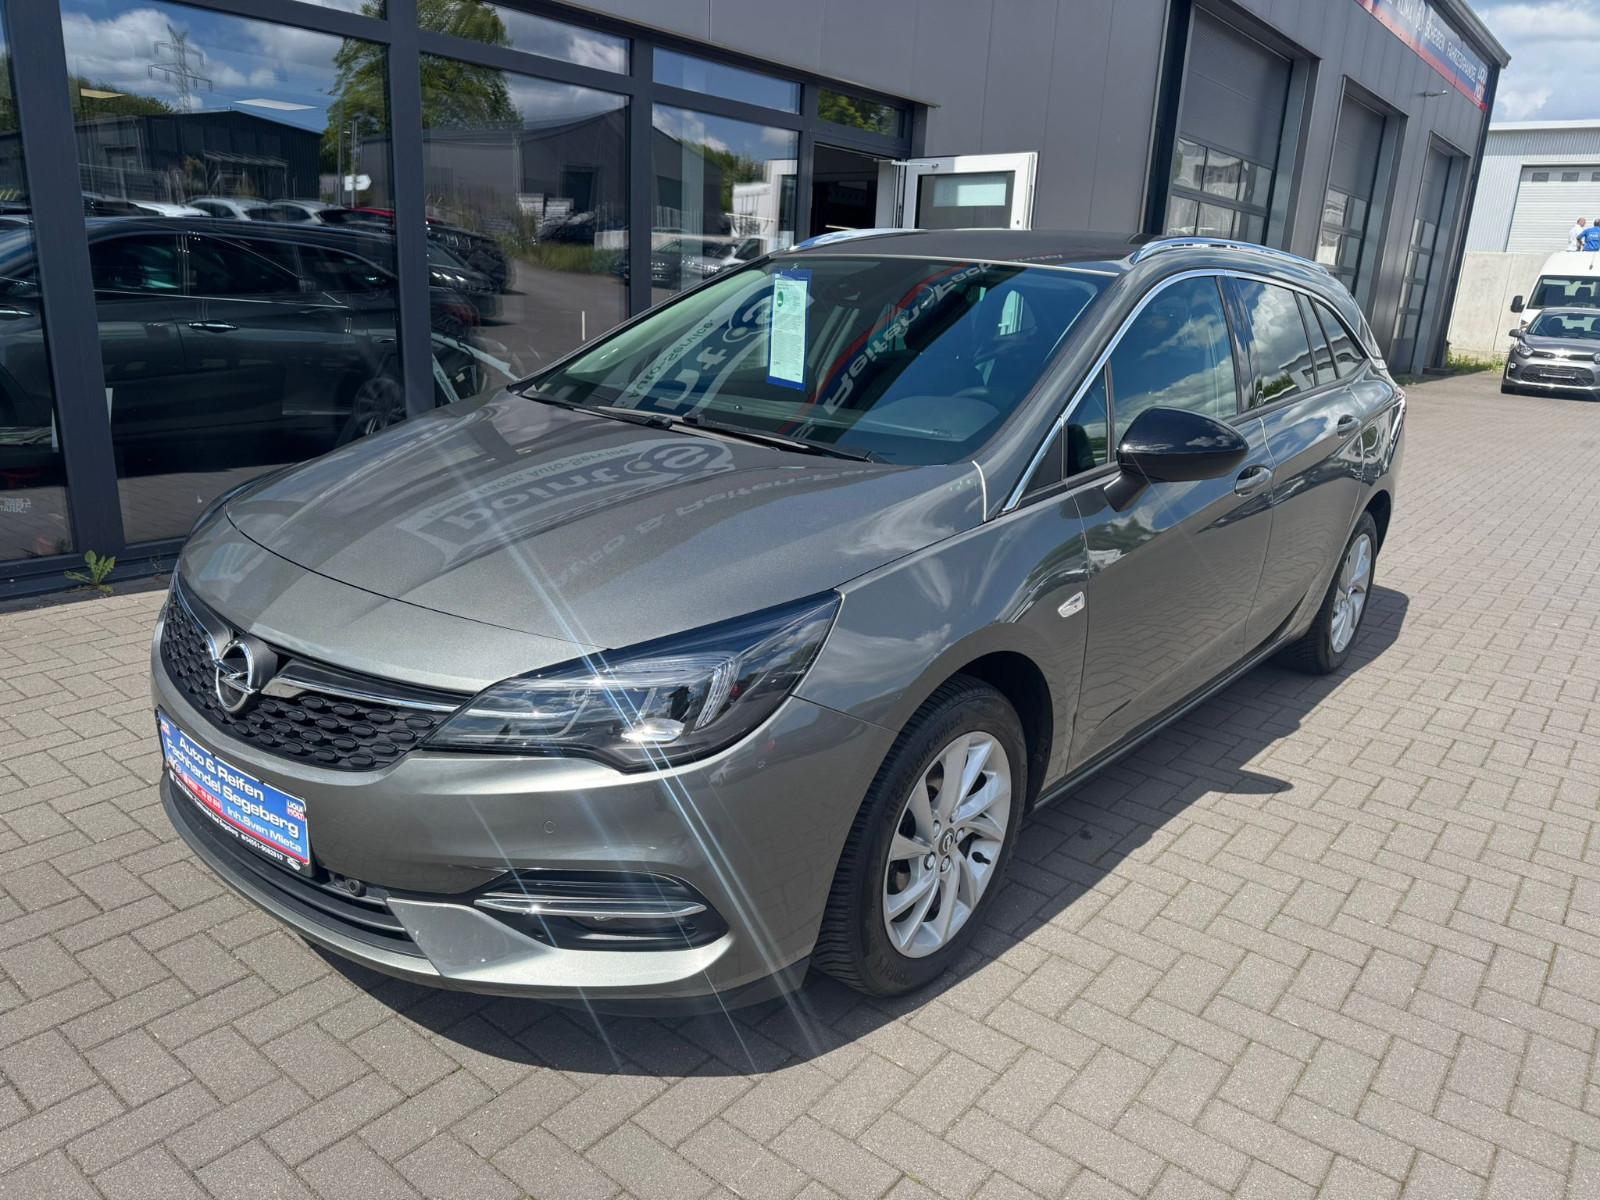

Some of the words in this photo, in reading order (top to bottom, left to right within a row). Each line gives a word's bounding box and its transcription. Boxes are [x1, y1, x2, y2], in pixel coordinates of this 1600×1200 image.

[166, 737, 221, 794] Fachhandel
[223, 785, 299, 839] Segeberg
[179, 737, 205, 766] Auto
[205, 757, 217, 775] &
[217, 764, 264, 802] Reifen
